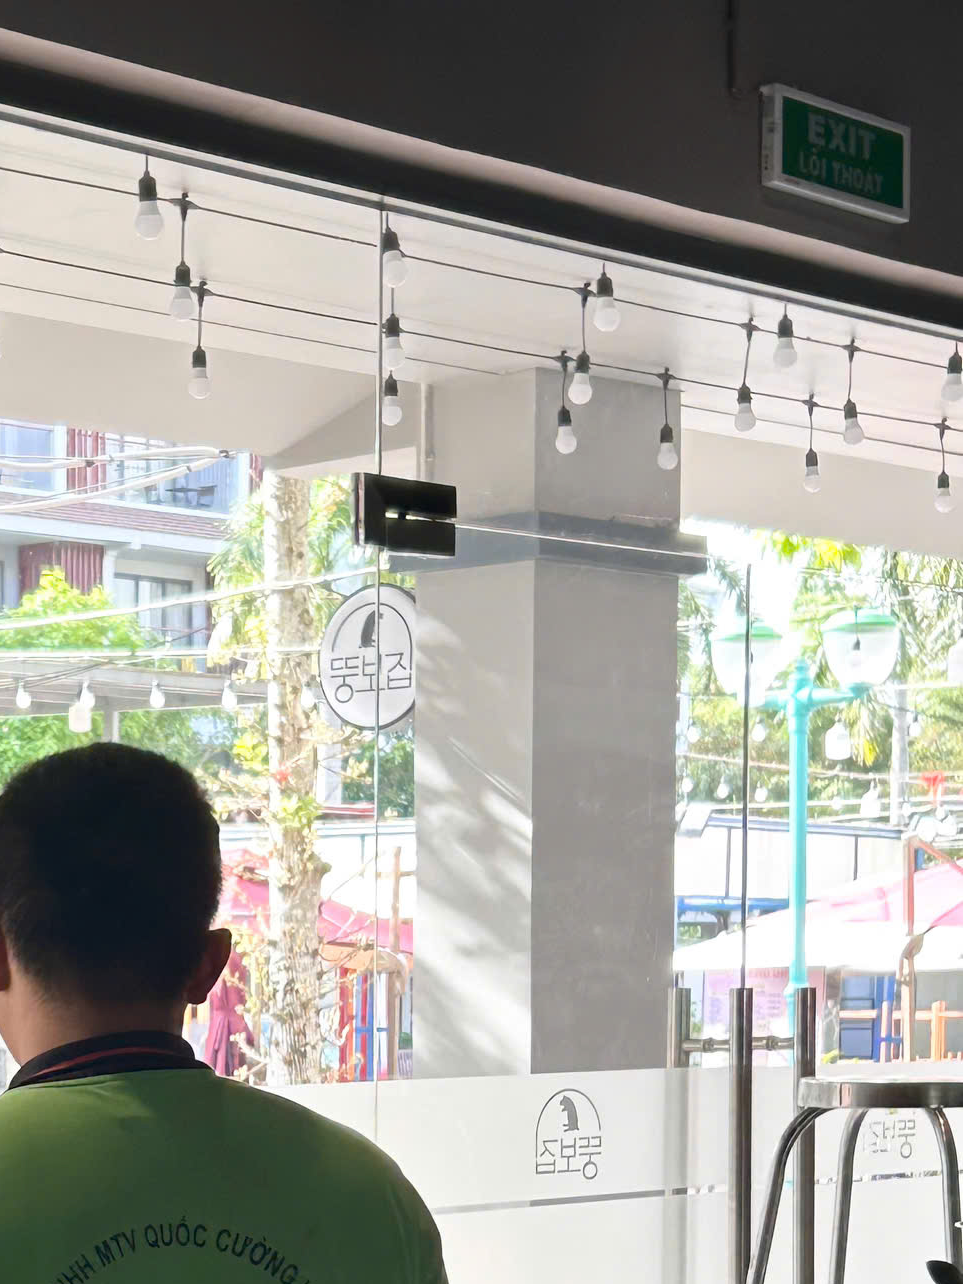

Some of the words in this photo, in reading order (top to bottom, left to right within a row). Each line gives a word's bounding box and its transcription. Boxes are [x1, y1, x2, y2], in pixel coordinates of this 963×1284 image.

[808, 111, 876, 161] EXIT
[330, 652, 412, 703] 뚱보집
[94, 1228, 138, 1268] MTV
[143, 1215, 207, 1249] QUỐC
